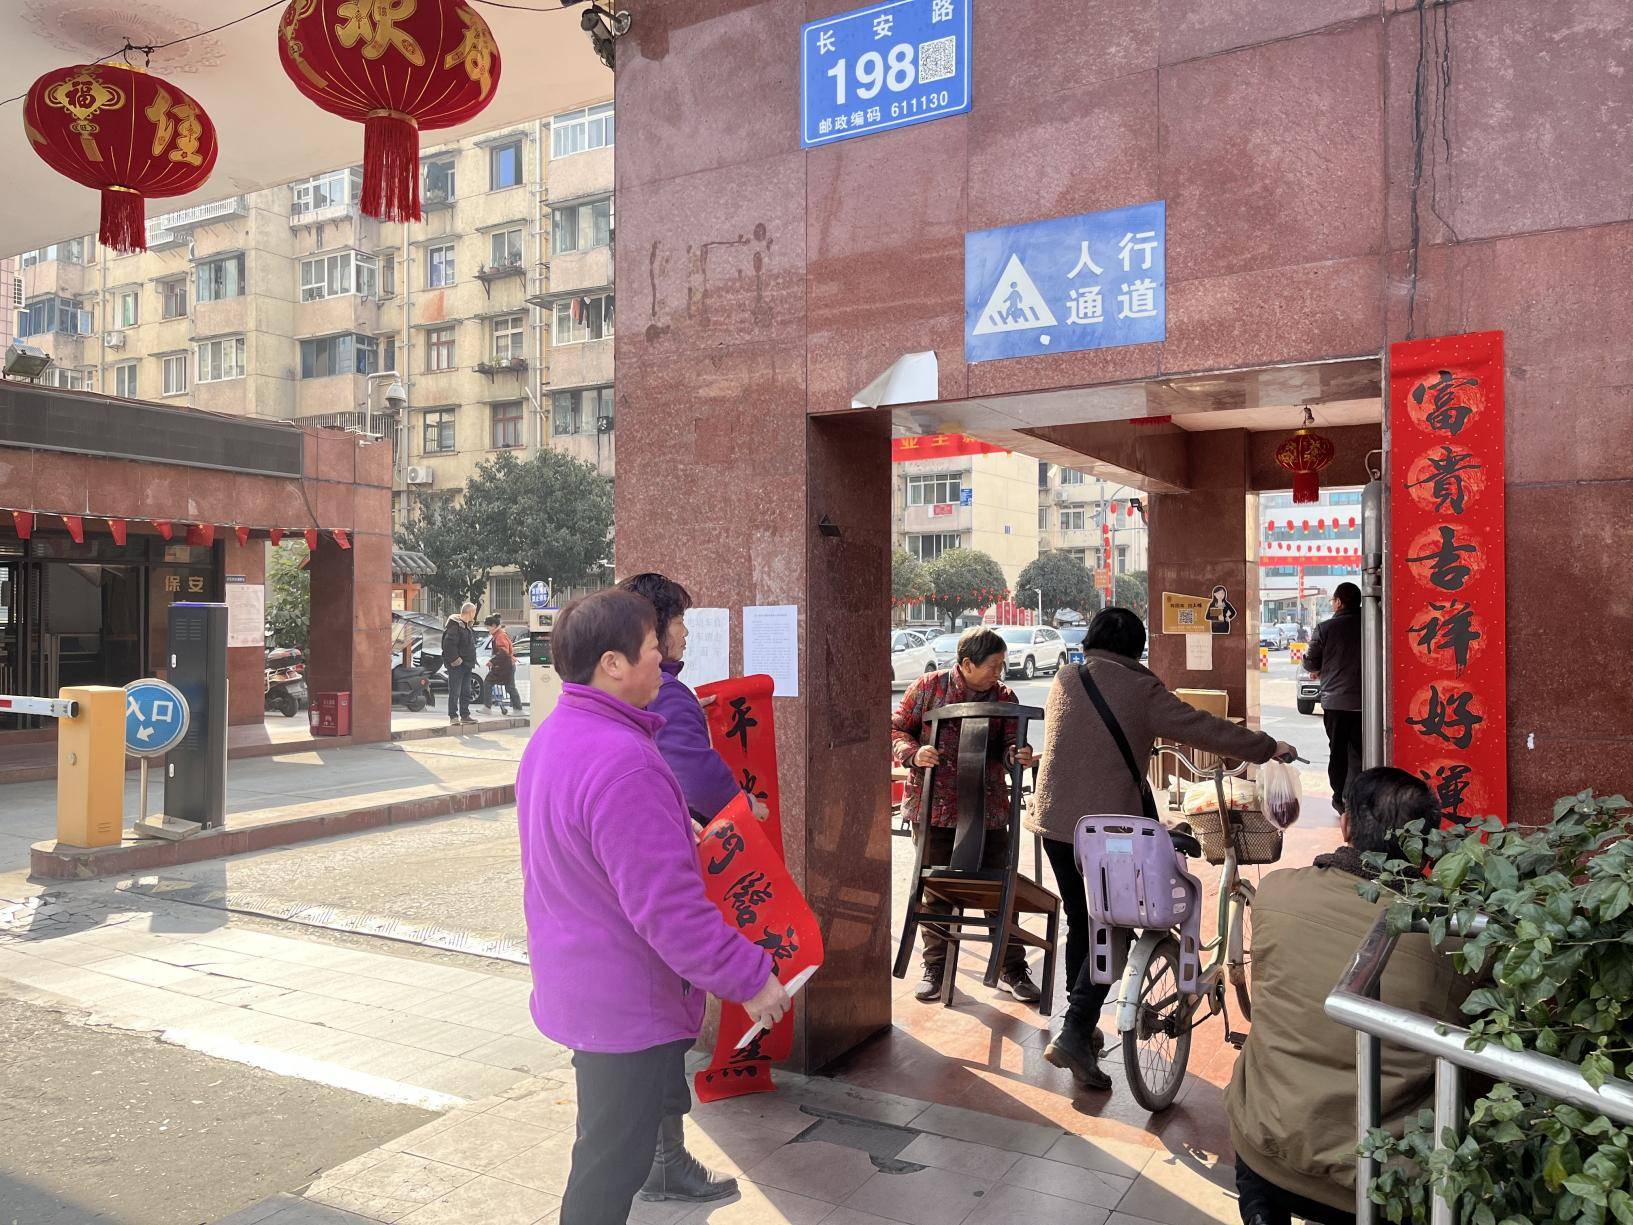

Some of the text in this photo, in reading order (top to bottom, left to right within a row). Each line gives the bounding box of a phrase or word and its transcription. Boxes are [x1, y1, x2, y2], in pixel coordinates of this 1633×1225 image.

[816, 0, 954, 55] 长安路
[827, 43, 916, 105] 198
[818, 91, 948, 134] 邮政编码 611130
[1067, 230, 1159, 280] 人行
[1065, 278, 1158, 327] 通道
[164, 576, 204, 592] 保安
[126, 695, 173, 722] 入口
